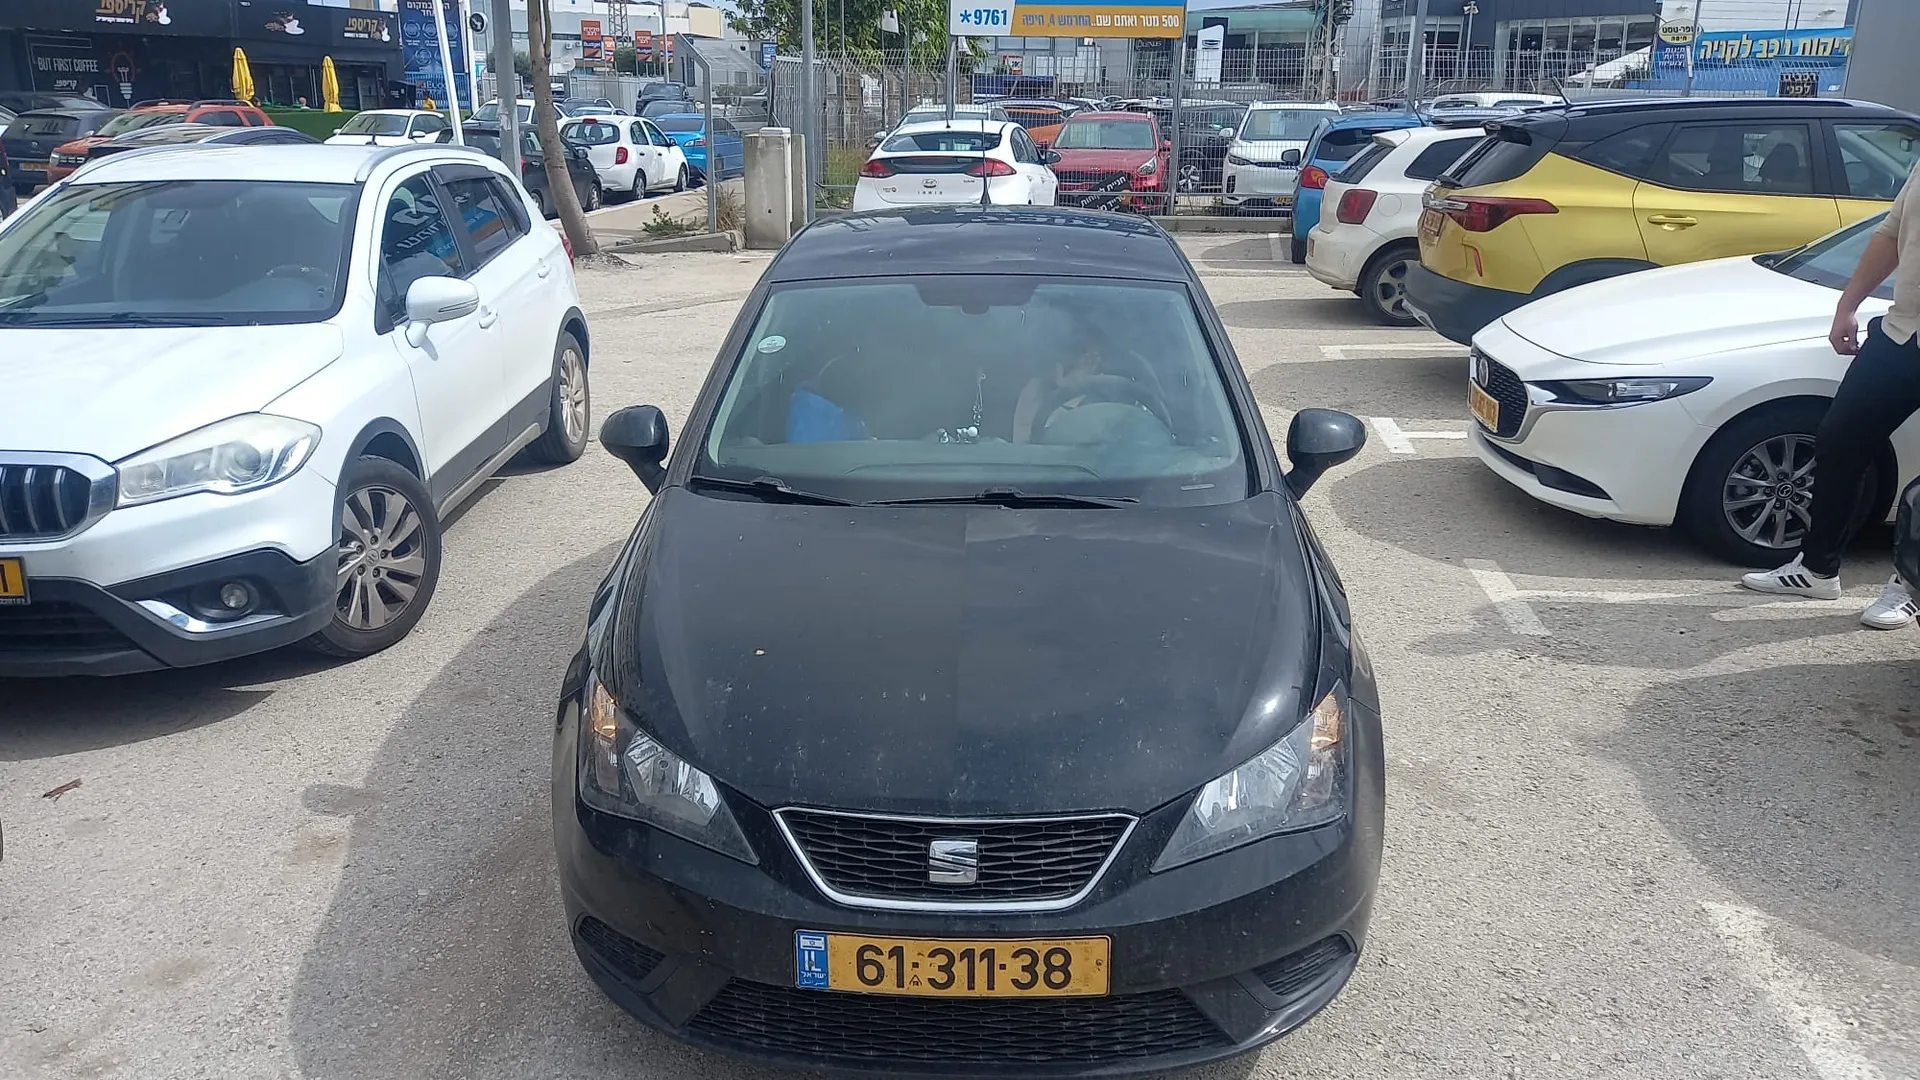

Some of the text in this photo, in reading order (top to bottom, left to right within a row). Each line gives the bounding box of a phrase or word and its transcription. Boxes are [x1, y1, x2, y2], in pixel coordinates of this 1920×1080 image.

[1023, 14, 1044, 25] חיפה
[1114, 15, 1137, 26] ואתם
[1140, 15, 1159, 27] מטר
[1162, 15, 1179, 27] 500
[1700, 34, 1751, 65] לקניה
[1756, 38, 1791, 59] רכב
[38, 57, 99, 73] BUT FIRST COFFEE
[804, 950, 822, 972] IL
